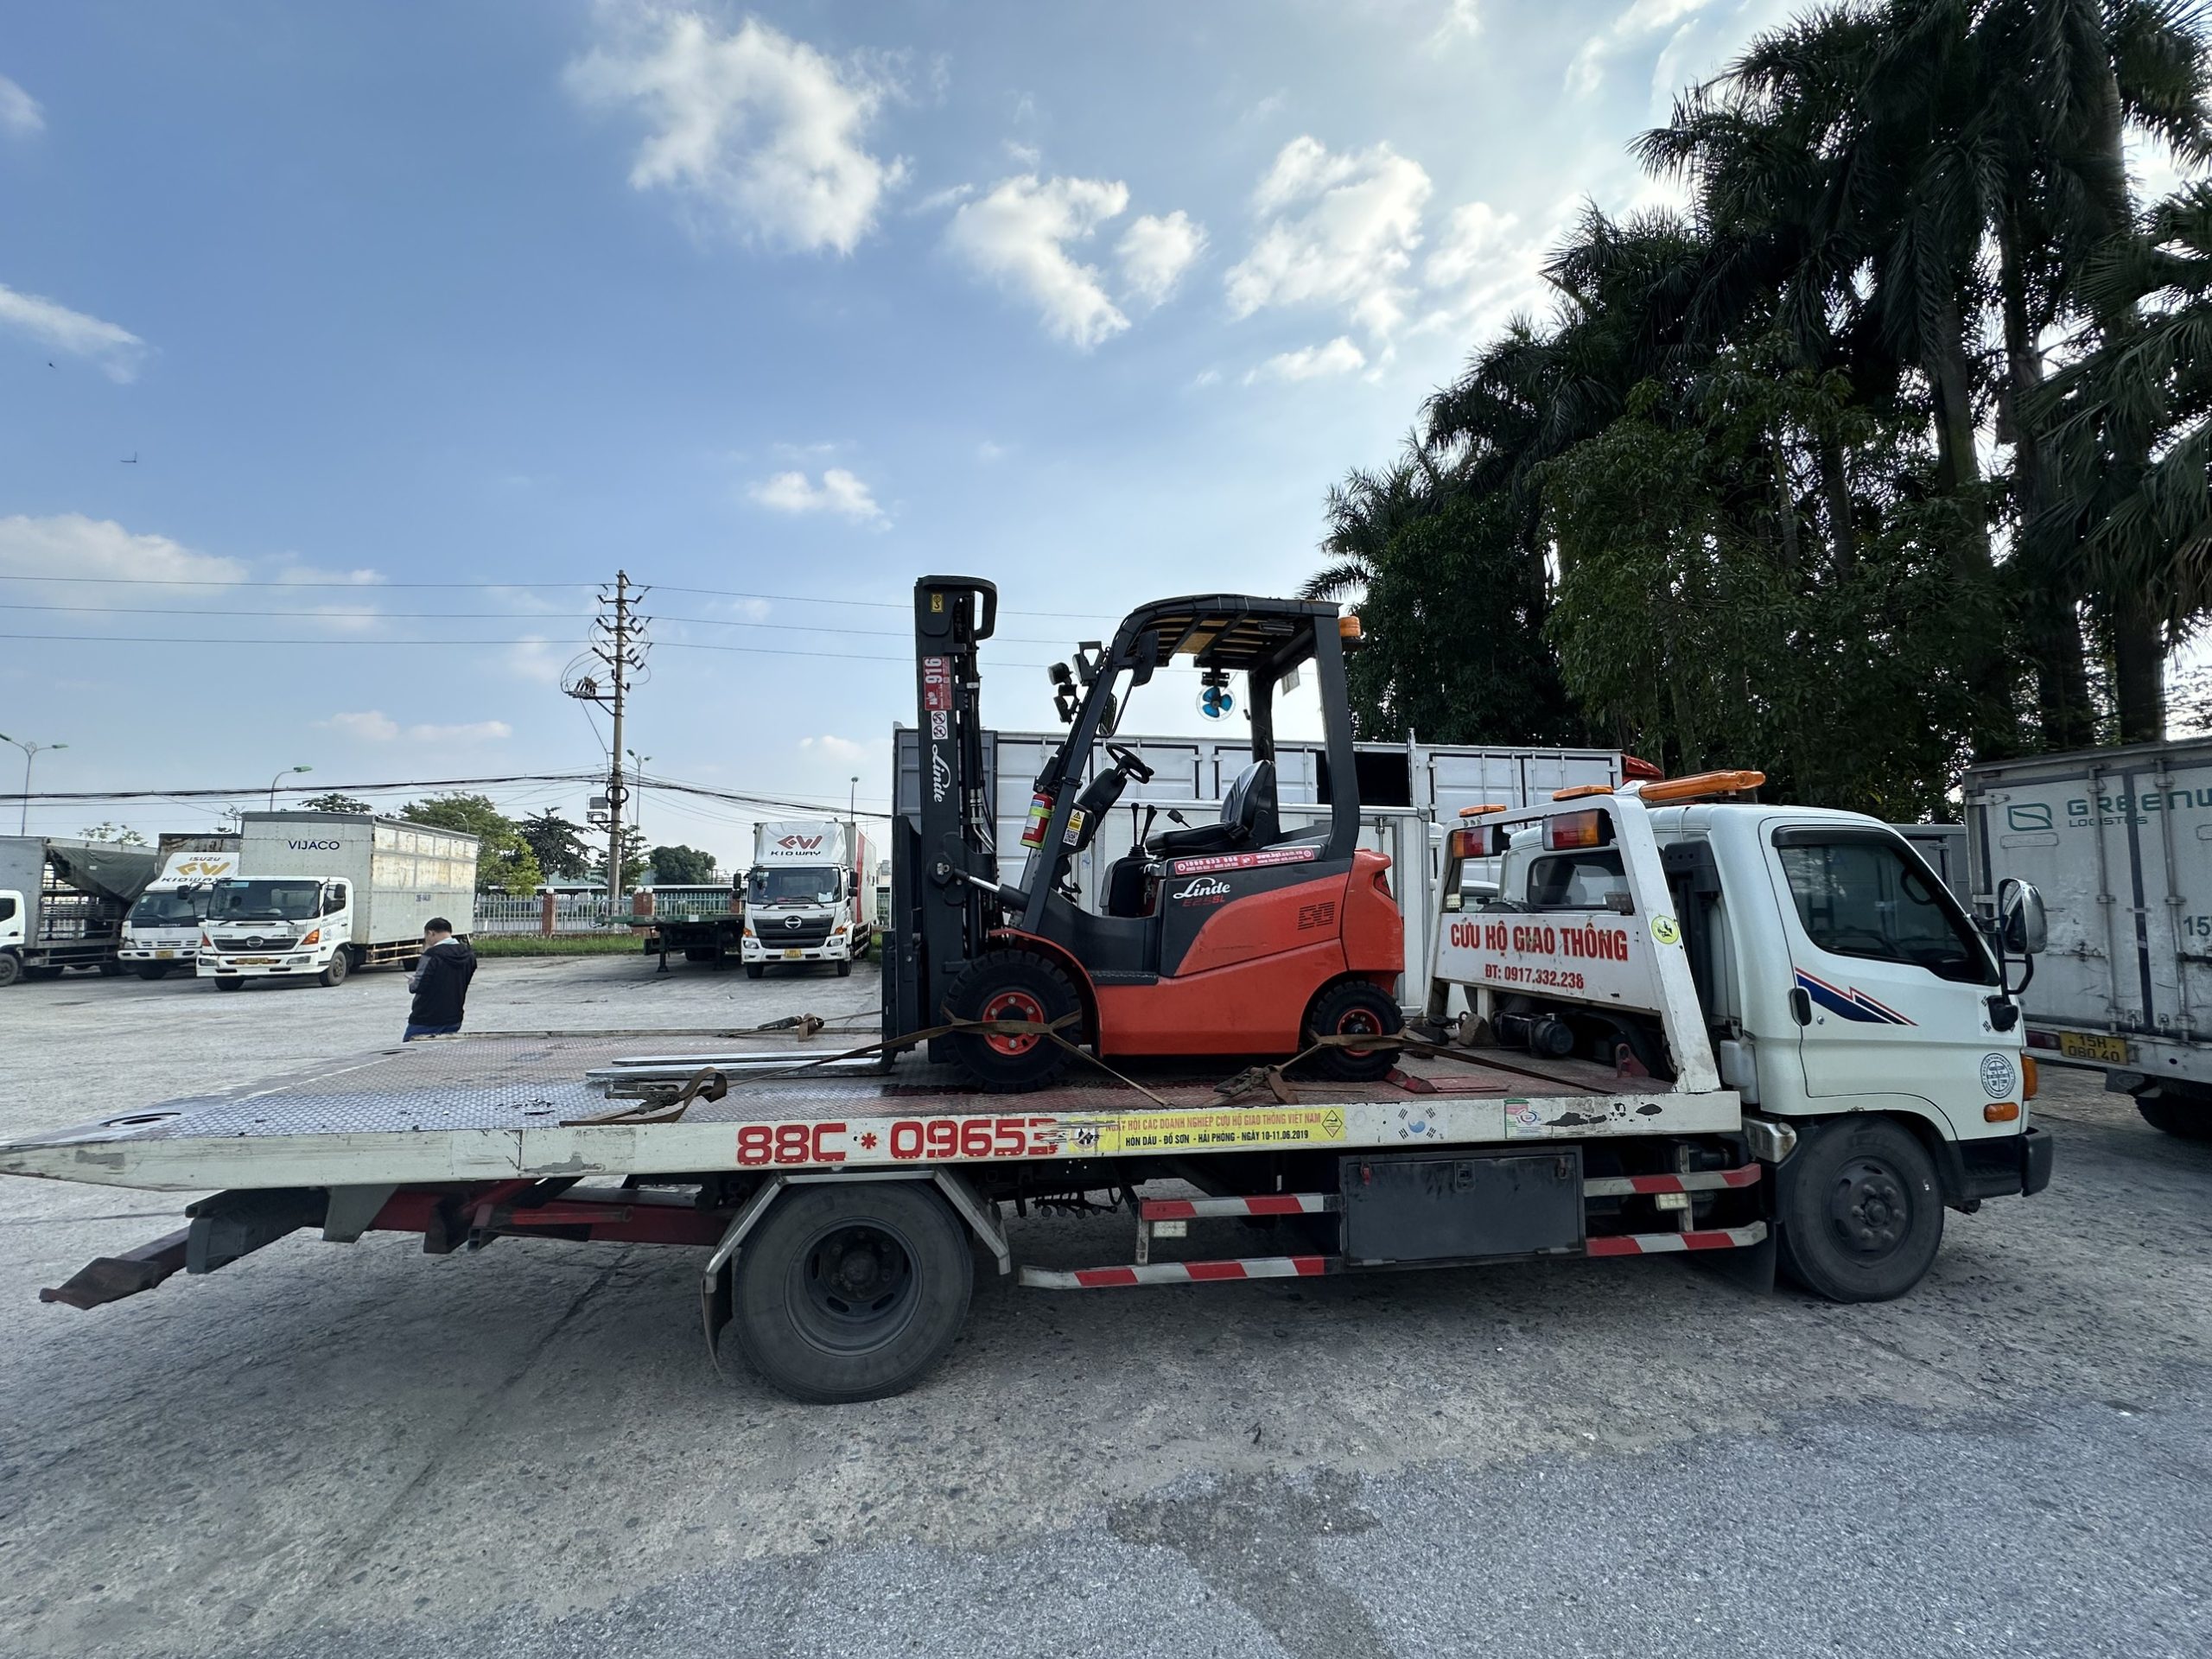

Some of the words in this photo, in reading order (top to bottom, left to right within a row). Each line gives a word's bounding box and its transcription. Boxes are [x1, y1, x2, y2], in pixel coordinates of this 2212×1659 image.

[932, 744, 951, 803] Linde
[289, 841, 340, 850] VIJACO
[1173, 877, 1231, 899] Linde
[2183, 916, 2212, 936] 15
[1485, 920, 1508, 957] HỘ
[1513, 925, 1555, 955] GIAO
[1560, 922, 1629, 961] THÔNG
[1484, 963, 1502, 981] ĐT:
[1504, 966, 1584, 989] 0917.332.238
[1160, 1117, 1185, 1129] DOANH
[1244, 1115, 1261, 1126] GIAO
[1305, 1112, 1321, 1123] NAM
[737, 1122, 847, 1166] 88C
